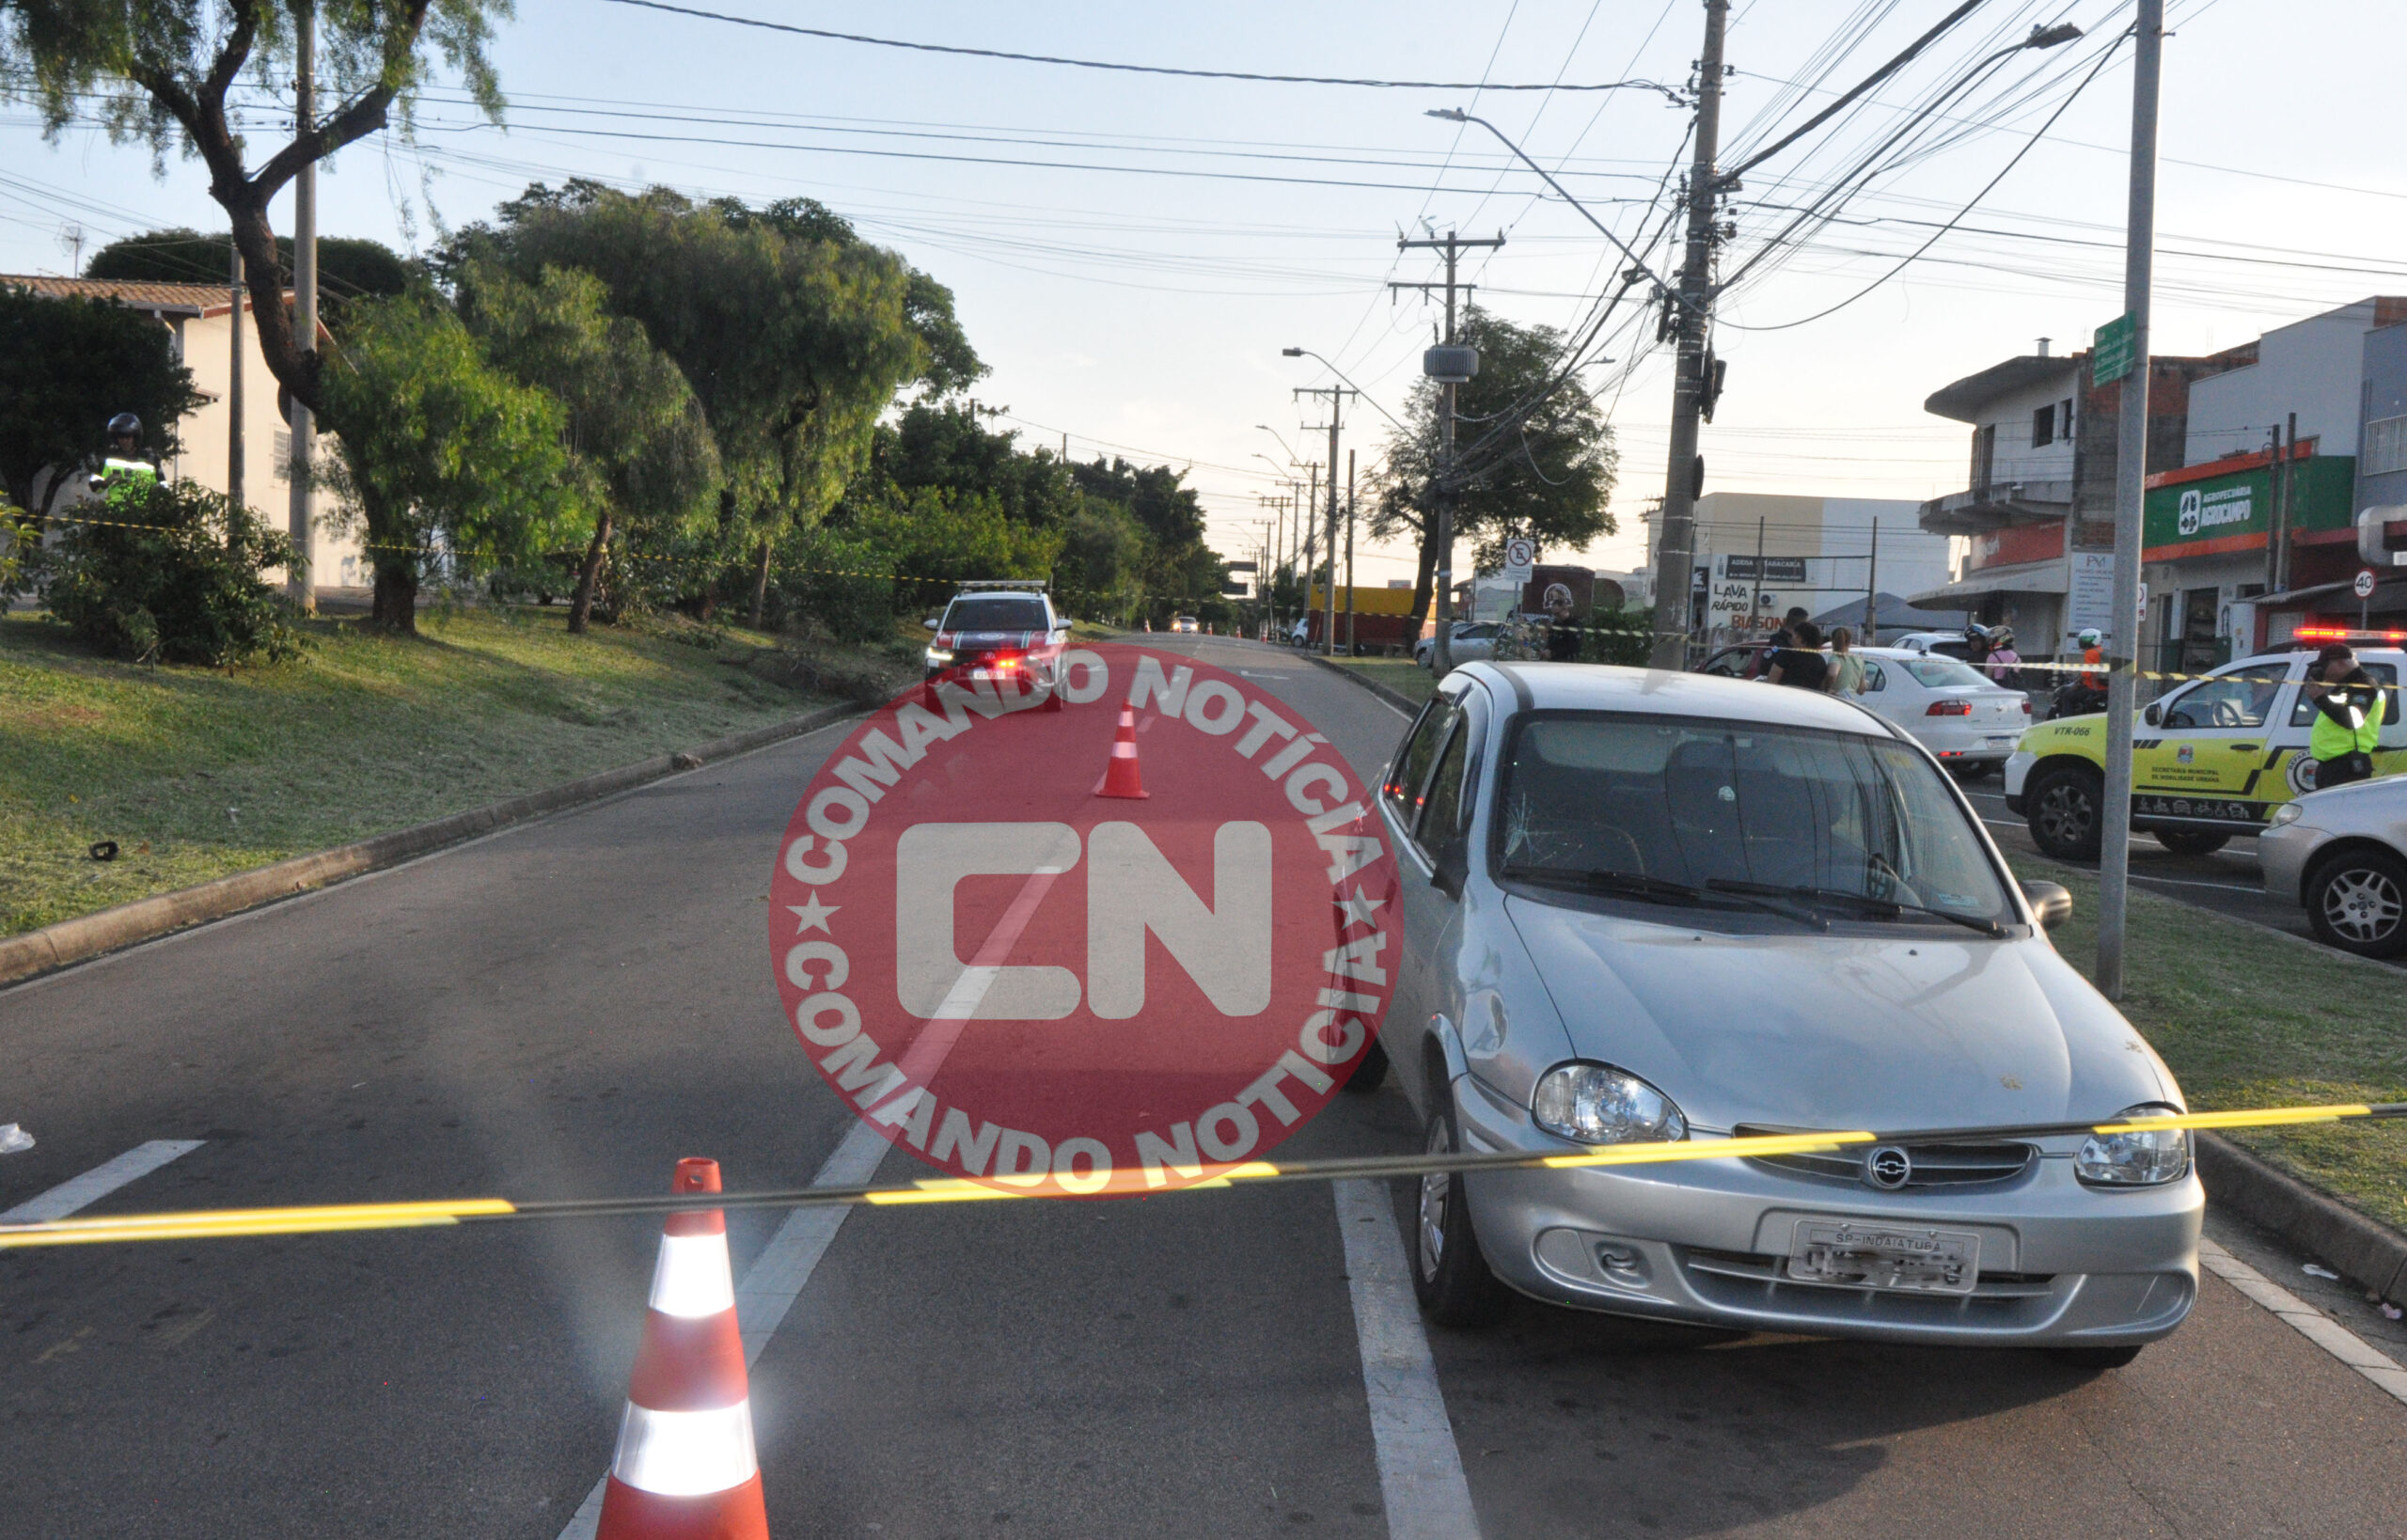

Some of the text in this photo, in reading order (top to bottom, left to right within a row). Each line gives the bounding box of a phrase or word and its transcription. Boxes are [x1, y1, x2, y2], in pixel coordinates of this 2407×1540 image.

[2200, 499, 2252, 527] AGROCAMPO
[2356, 576, 2373, 589] 40
[1713, 583, 1747, 599] LAVA
[1711, 599, 1749, 612] RÁPIDO
[2053, 727, 2091, 737] VTR-066
[1835, 1234, 1941, 1250] SP-INDAIATUBA
